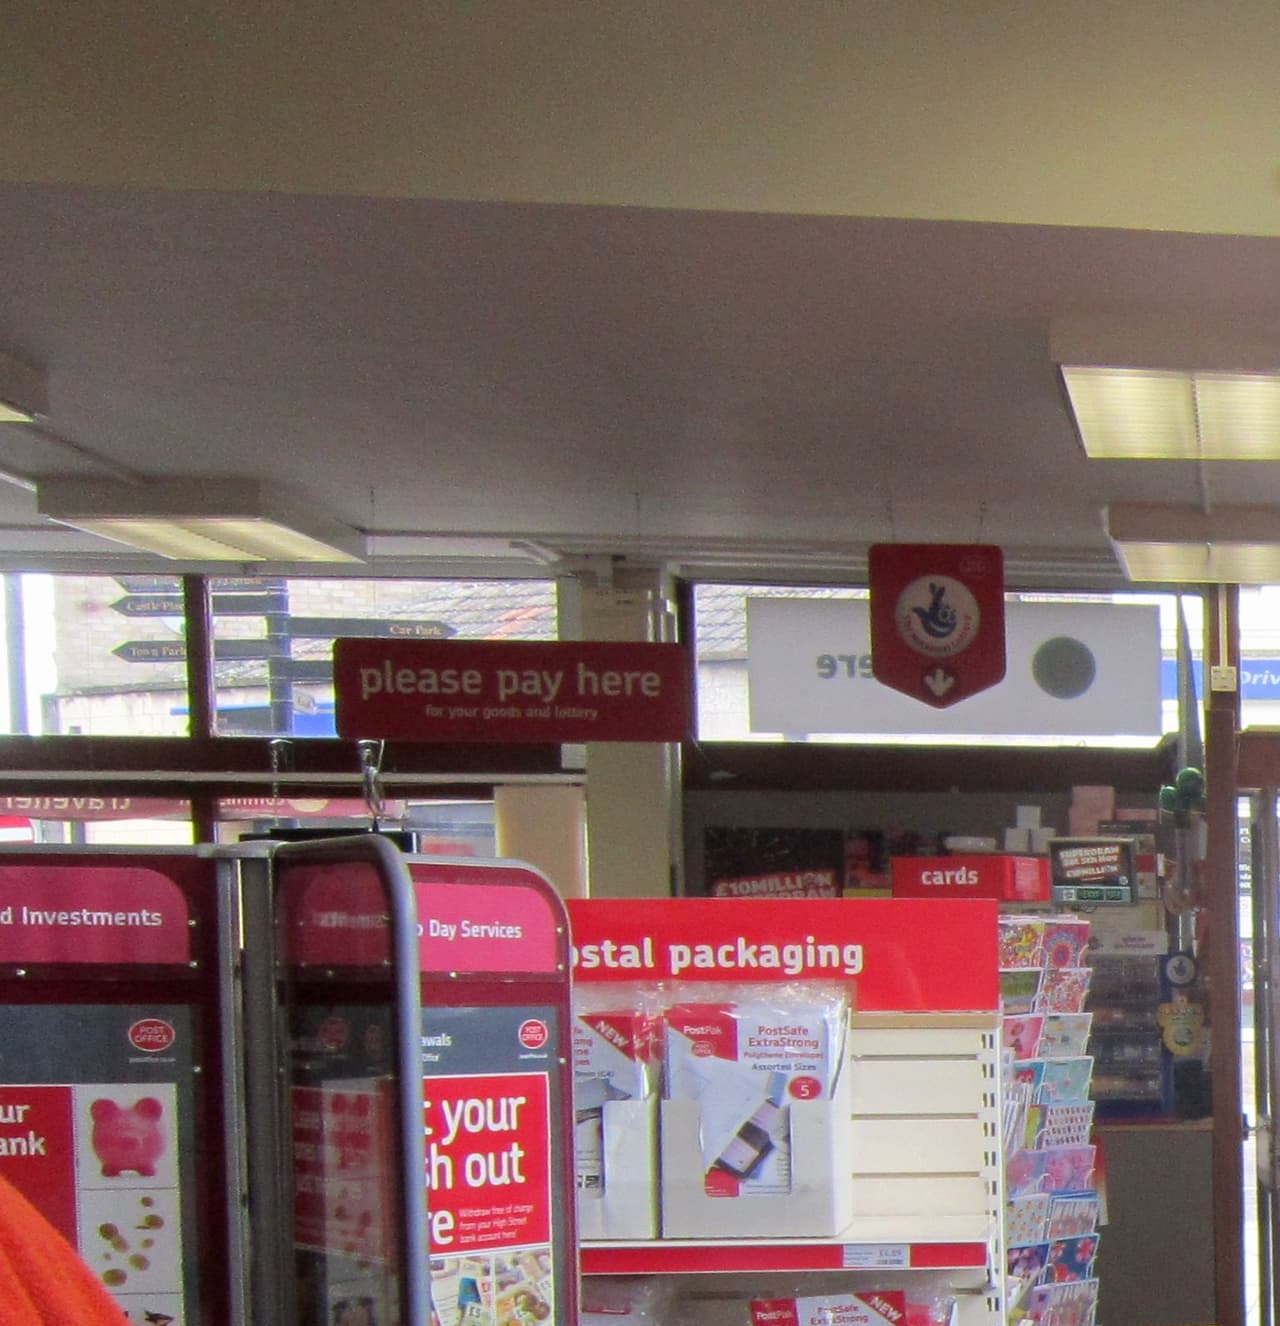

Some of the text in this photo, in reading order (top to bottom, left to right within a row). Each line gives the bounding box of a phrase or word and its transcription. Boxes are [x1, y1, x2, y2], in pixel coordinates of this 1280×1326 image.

[389, 625, 443, 637] Car Park
[360, 660, 661, 702] please pay here
[425, 704, 599, 721] for your goods and lottery
[920, 866, 979, 887] cards
[22, 907, 163, 927] Investments
[430, 919, 457, 941] Day
[460, 920, 523, 939] Services
[668, 936, 864, 975] packaging
[134, 1034, 168, 1044] OFFICE
[140, 1025, 164, 1036] POST
[594, 1020, 629, 1049] NEW
[682, 1024, 723, 1036] PostPak
[757, 1025, 809, 1037] PostSafe
[748, 1036, 819, 1050] ExtraStrong
[751, 1062, 817, 1072] Assorted Sizes
[801, 1083, 810, 1097] 5
[441, 1095, 527, 1145] your
[464, 1143, 526, 1188] out
[870, 1296, 903, 1322] NEW
